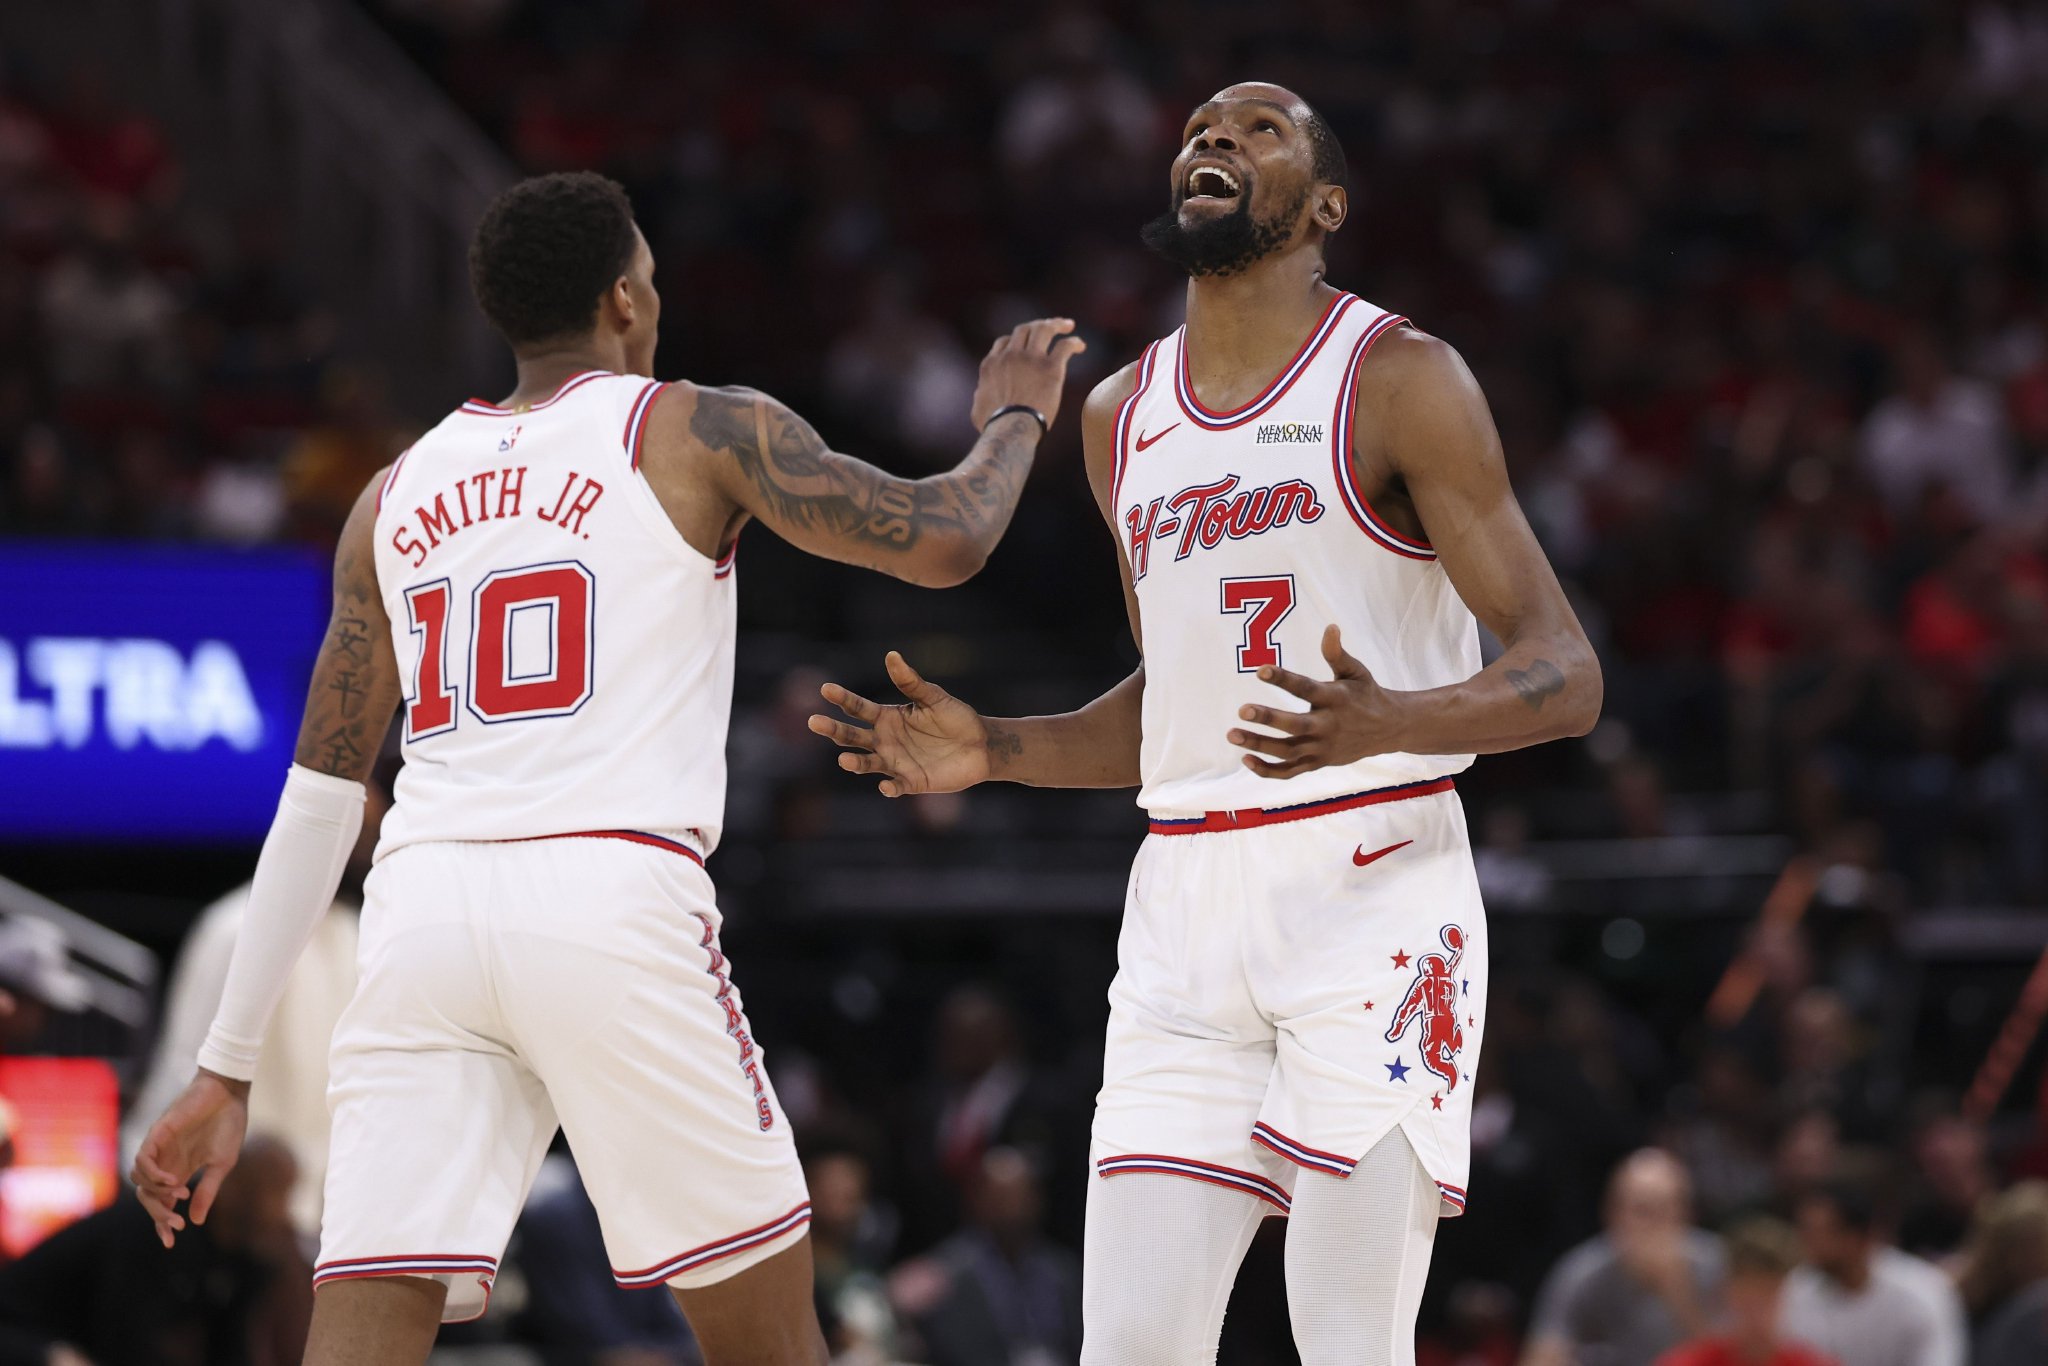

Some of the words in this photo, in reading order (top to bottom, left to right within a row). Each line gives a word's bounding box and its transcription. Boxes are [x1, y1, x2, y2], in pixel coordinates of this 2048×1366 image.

[1256, 433, 1322, 443] HERMANN
[1257, 424, 1323, 435] MEMORIAL
[393, 467, 527, 568] SMITH
[537, 472, 604, 540] JR.
[1126, 474, 1325, 589] H-Town
[403, 560, 595, 744] 10
[1220, 574, 1296, 673] 7
